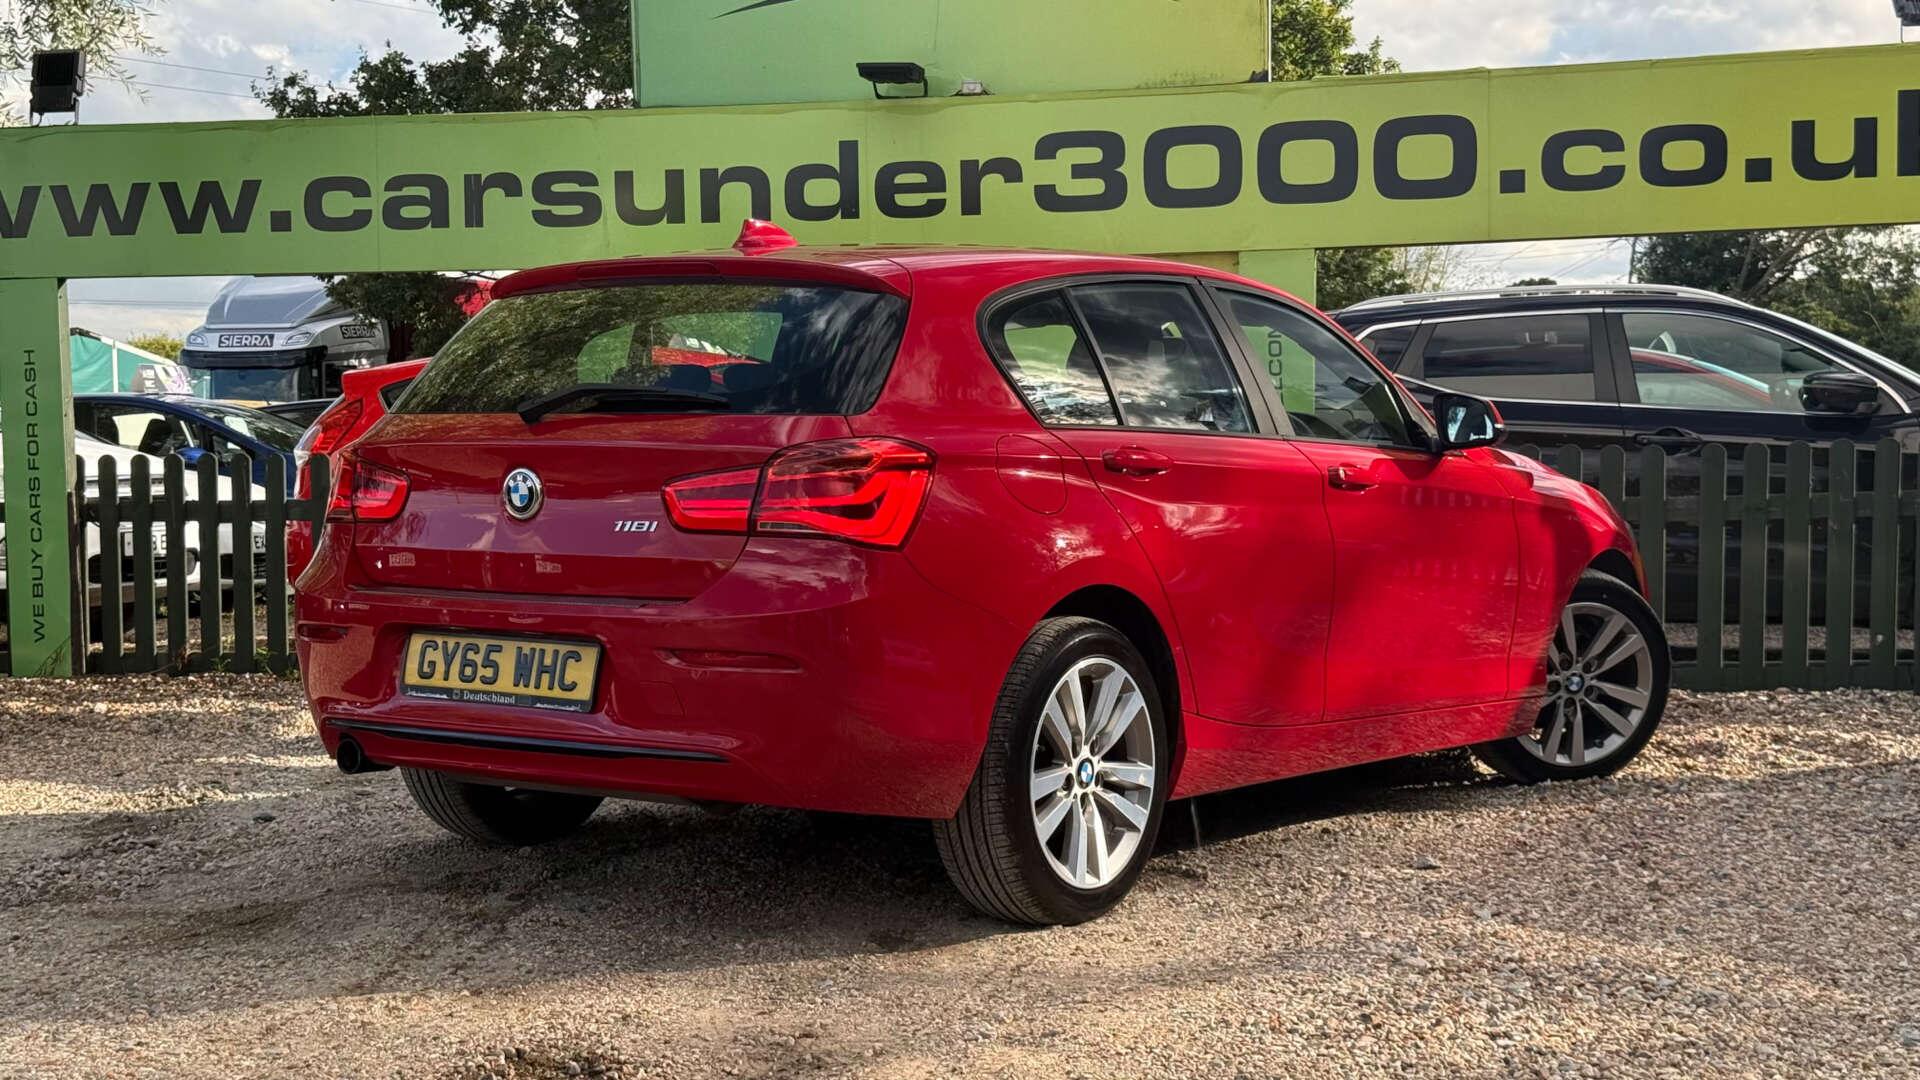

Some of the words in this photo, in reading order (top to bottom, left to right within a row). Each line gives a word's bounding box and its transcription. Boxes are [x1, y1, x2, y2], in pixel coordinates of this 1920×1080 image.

[0, 88, 1920, 239] ww.carsunder3000.co.u
[220, 335, 271, 347] SIERRA
[24, 349, 37, 416] CASH
[27, 423, 40, 471] FOR
[29, 477, 42, 542] CARS
[31, 548, 44, 598] BUY
[33, 604, 45, 643] WE
[417, 639, 503, 685] GY65
[513, 646, 581, 692] WHC
[463, 690, 515, 704] Deutschland
